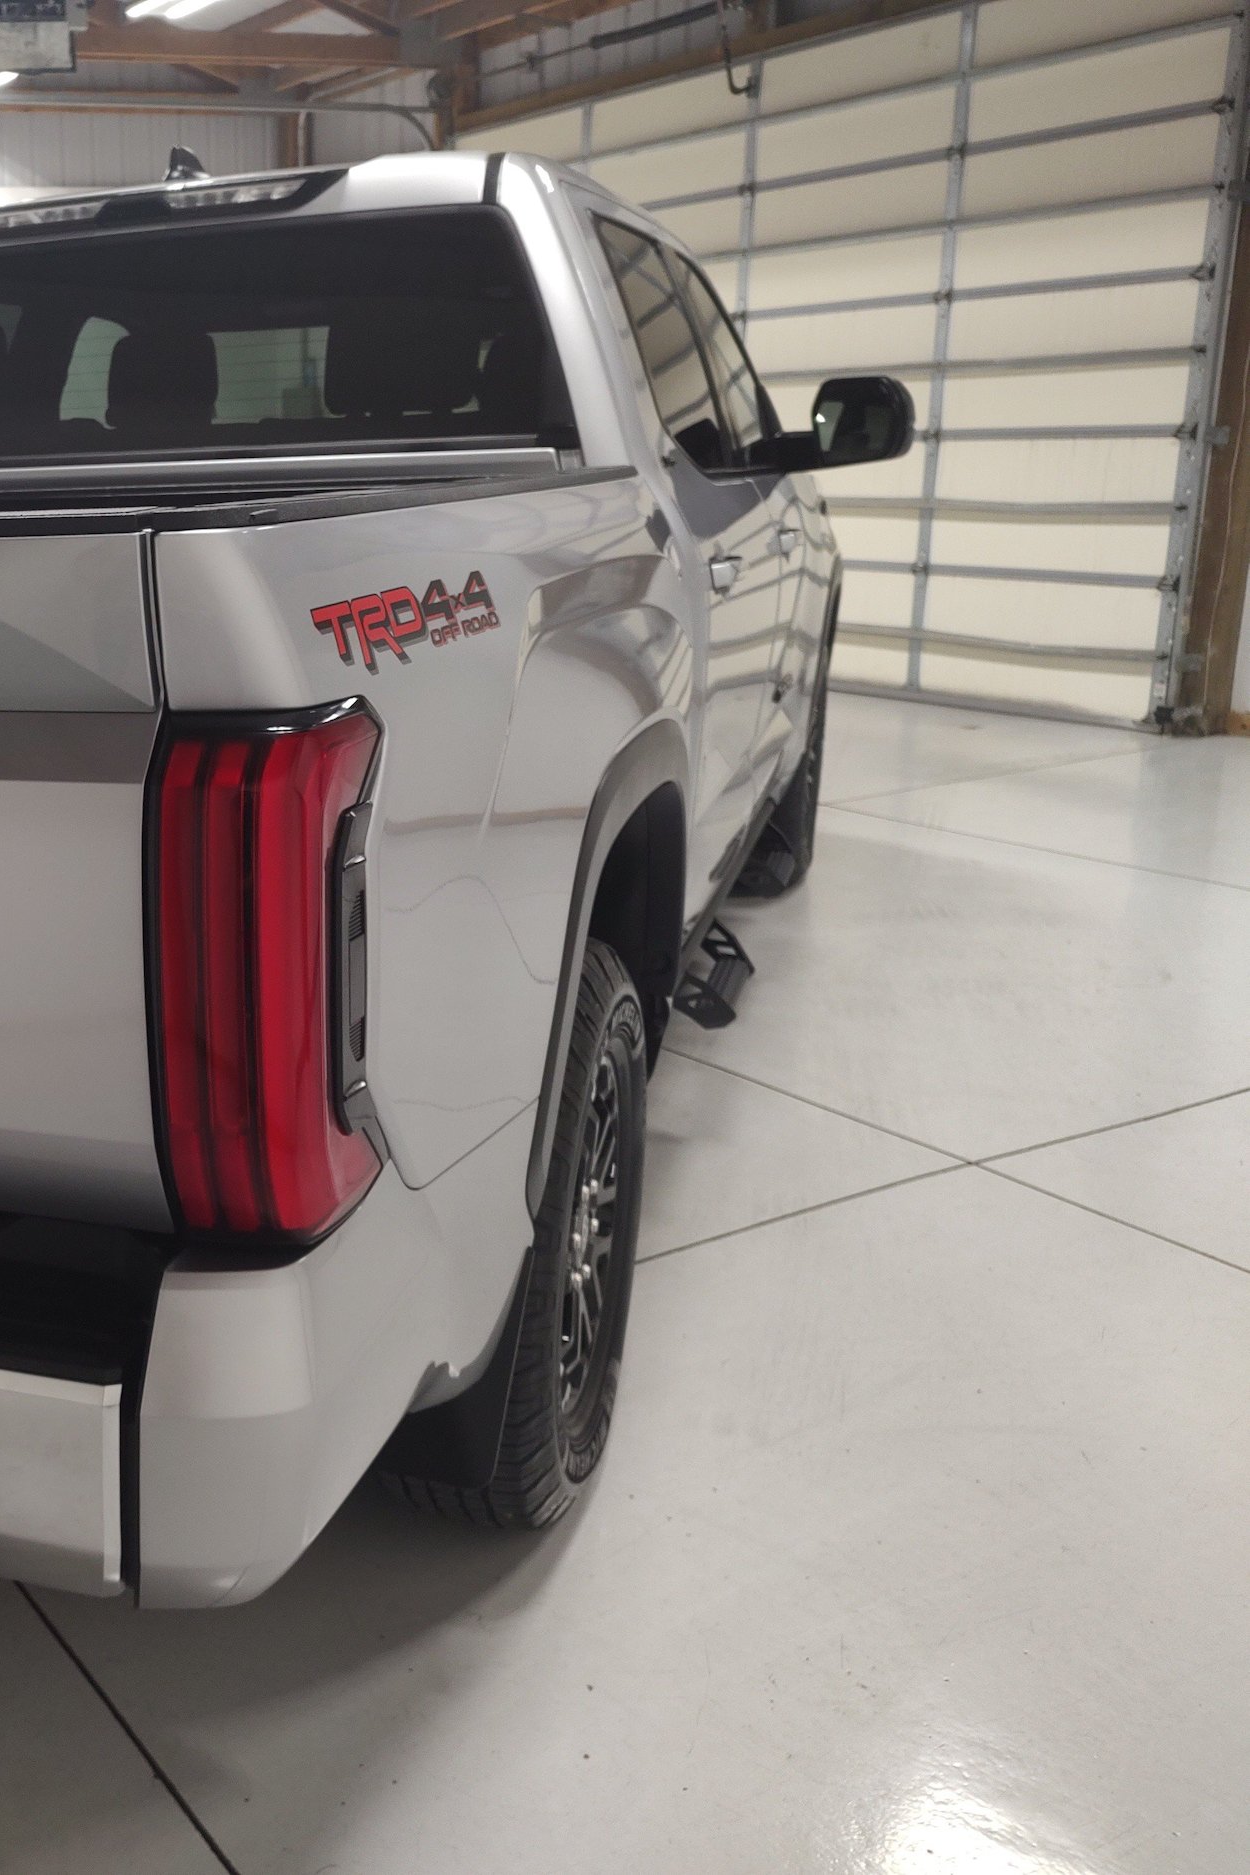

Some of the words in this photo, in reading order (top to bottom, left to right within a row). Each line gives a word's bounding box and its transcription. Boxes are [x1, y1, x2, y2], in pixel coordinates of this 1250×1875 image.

[310, 585, 429, 676] TRD
[430, 626, 463, 648] OFF
[461, 611, 501, 639] ROAD
